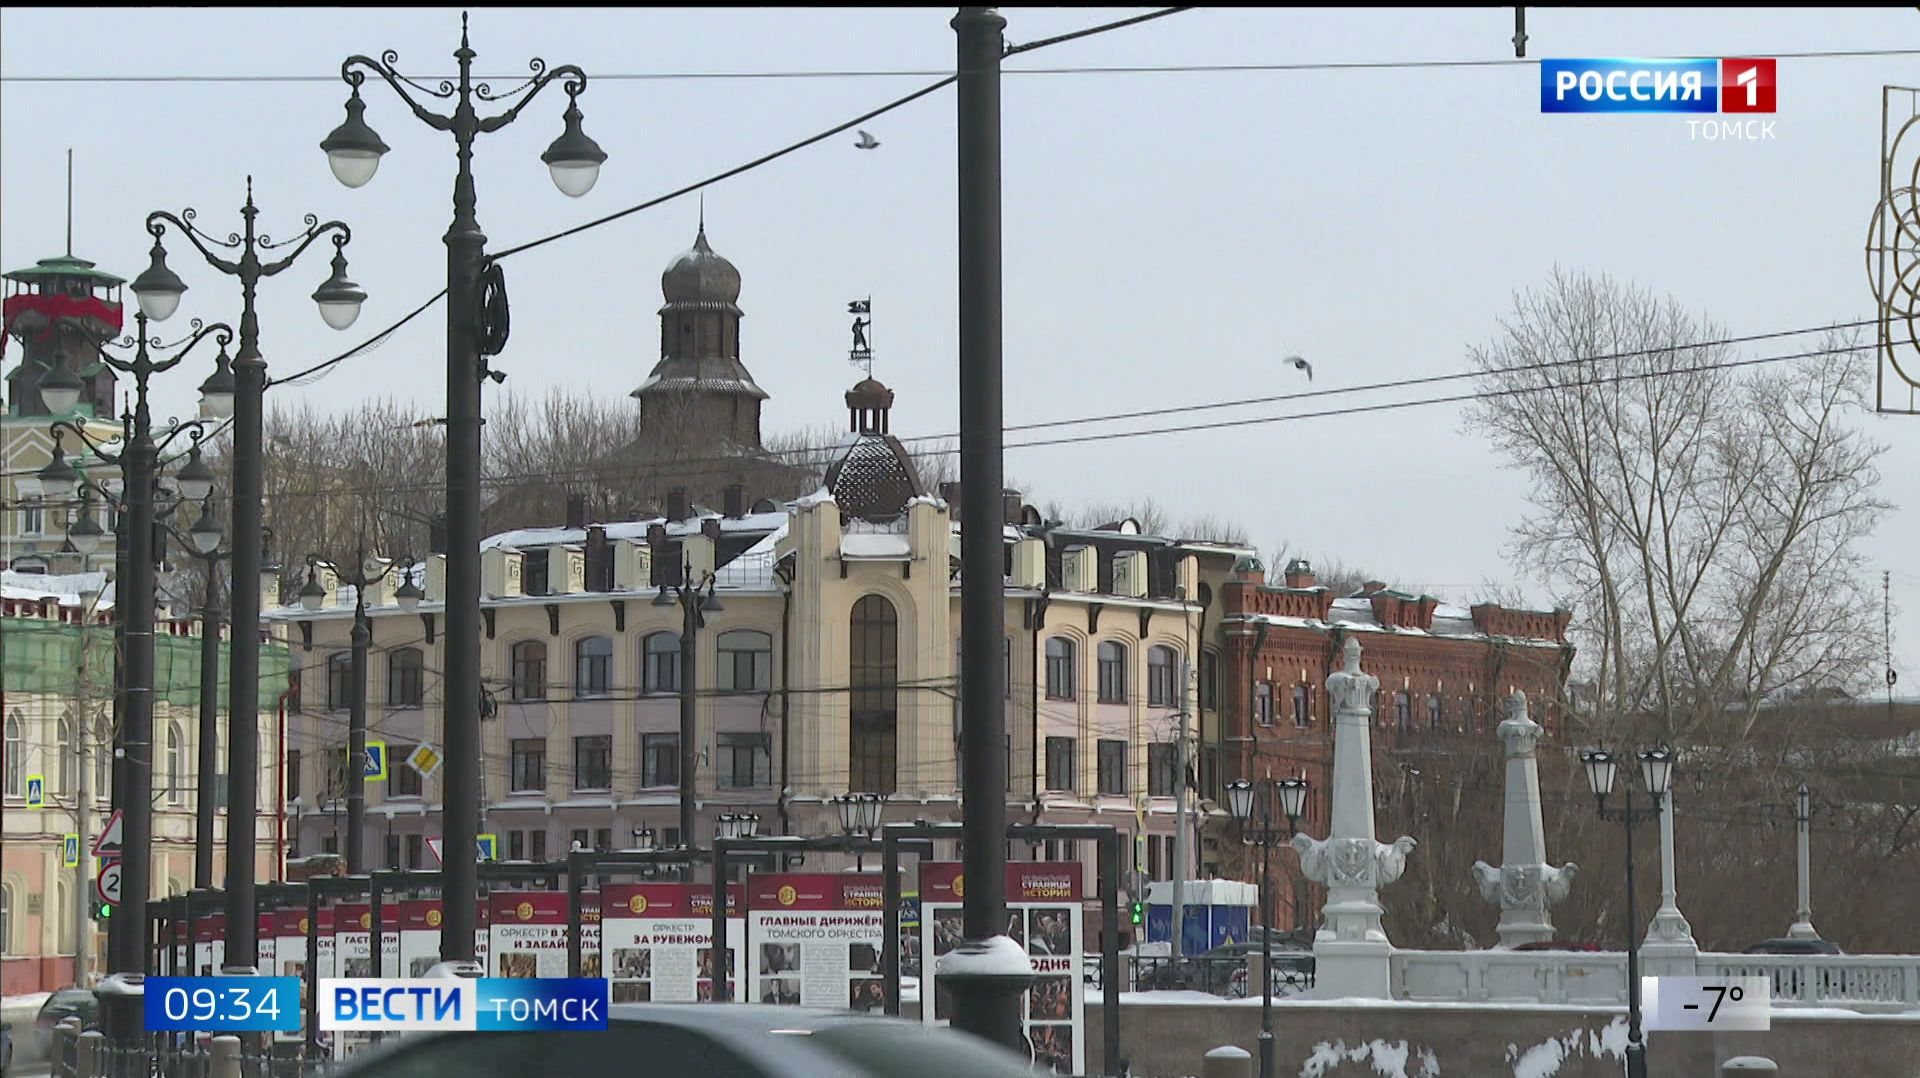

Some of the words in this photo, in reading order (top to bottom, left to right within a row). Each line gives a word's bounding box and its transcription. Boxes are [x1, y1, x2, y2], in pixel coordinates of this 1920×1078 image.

[106, 873, 120, 893] 2
[1022, 888, 1072, 897] ИСТОРИИ
[843, 898, 884, 907] ИСТОРИ
[760, 916, 817, 927] ГЛАВНЫЕ
[500, 928, 549, 938] ОРКЕСТР
[652, 924, 695, 932] ОРКЕСТР
[767, 928, 825, 939] ТОМСКОГО
[828, 928, 883, 939] ОРКЕСТРА
[514, 939, 522, 949] И
[633, 934, 649, 945] ЗА
